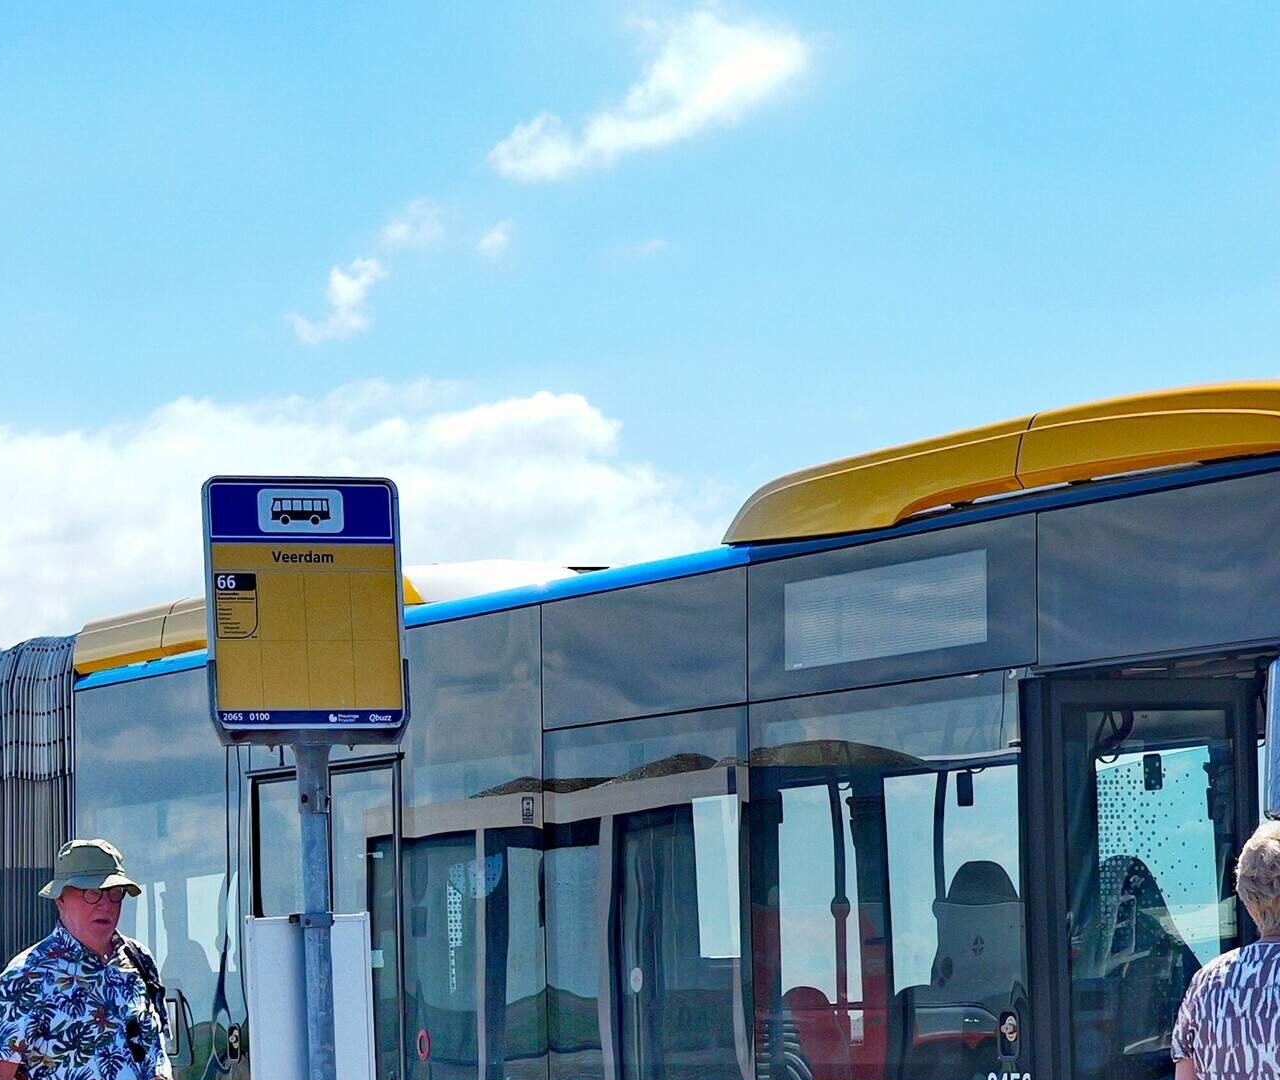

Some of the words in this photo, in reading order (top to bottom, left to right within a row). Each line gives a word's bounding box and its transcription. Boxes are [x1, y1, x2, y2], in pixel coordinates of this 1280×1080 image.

[271, 550, 334, 563] Veerdam
[217, 575, 236, 589] 66
[223, 713, 243, 721] 2065
[249, 713, 270, 721] 0100
[369, 713, 392, 723] Qbuzz
